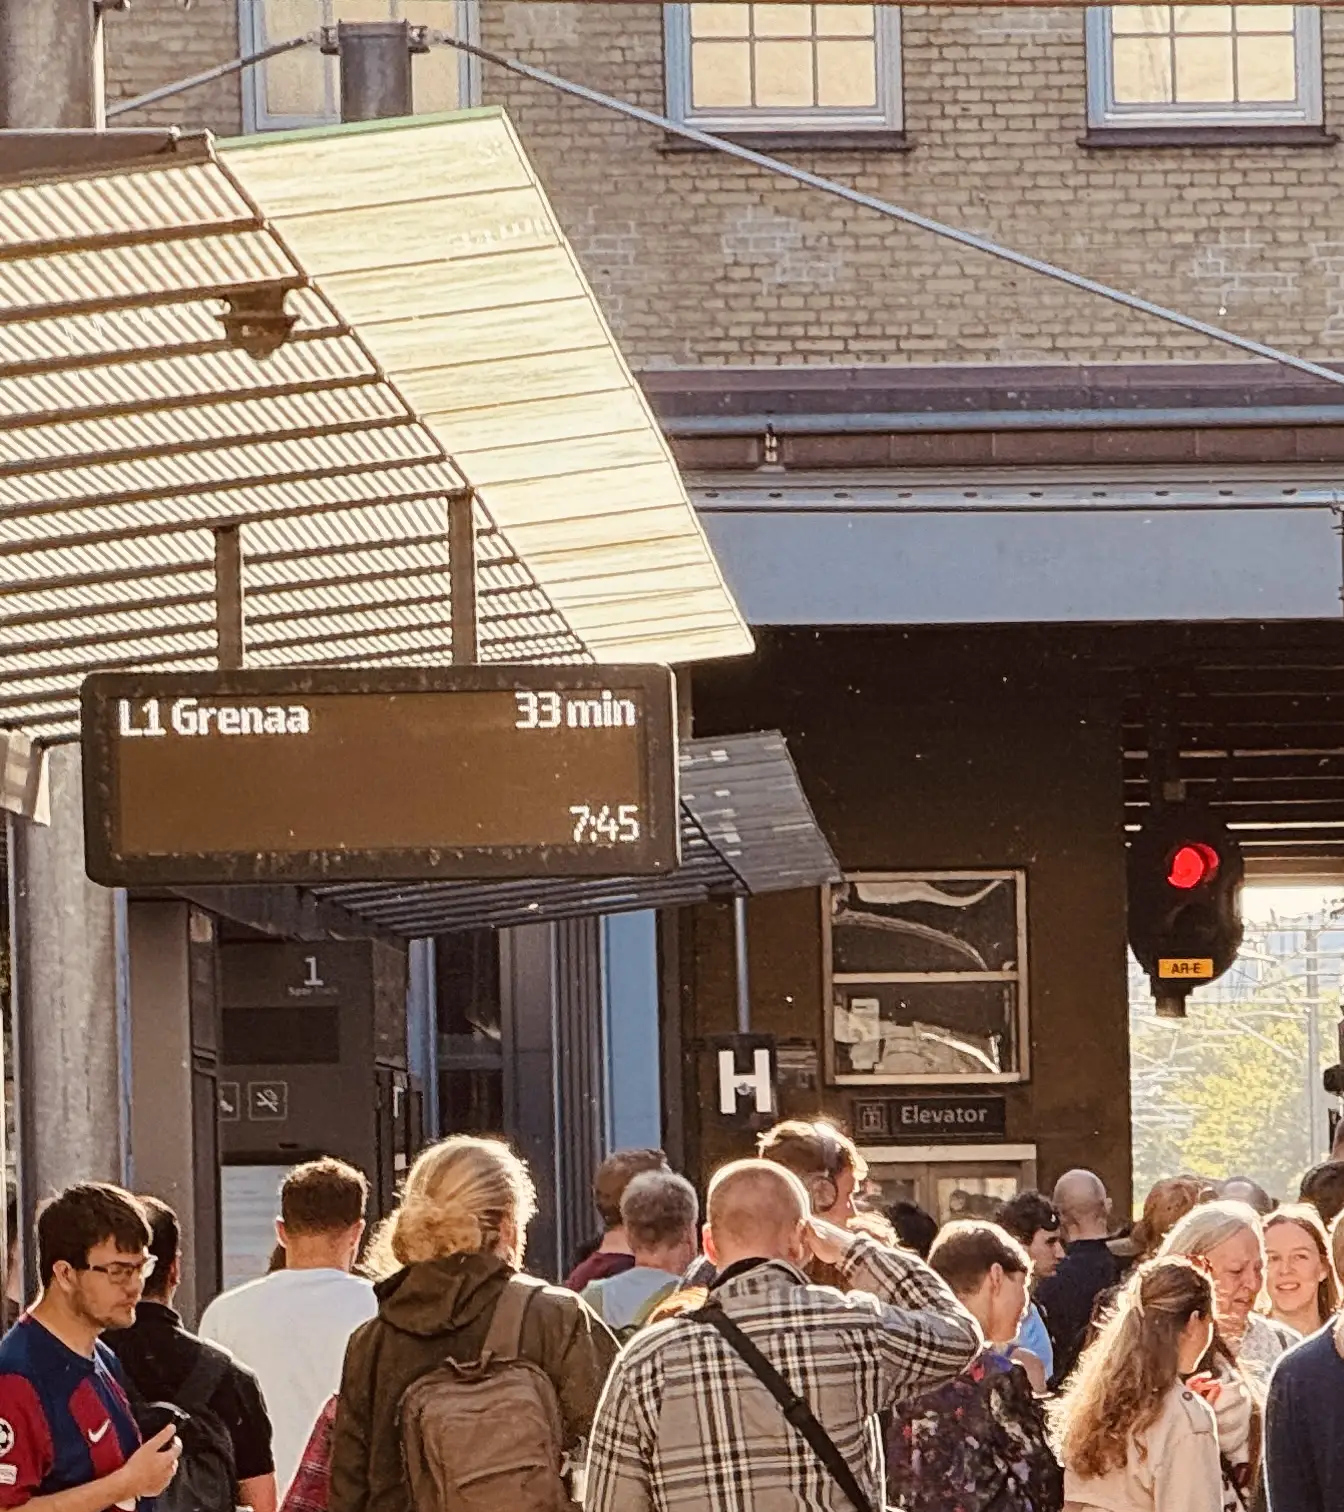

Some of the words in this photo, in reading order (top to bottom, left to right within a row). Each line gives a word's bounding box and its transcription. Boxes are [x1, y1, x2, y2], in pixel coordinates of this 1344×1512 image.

[119, 699, 166, 737] L1
[172, 697, 310, 736] Grenaa
[515, 691, 561, 728] 33
[566, 689, 636, 727] min
[569, 804, 638, 842] 7:45
[304, 956, 324, 986] 1
[718, 1049, 772, 1114] H
[901, 1105, 988, 1124] Elevator
